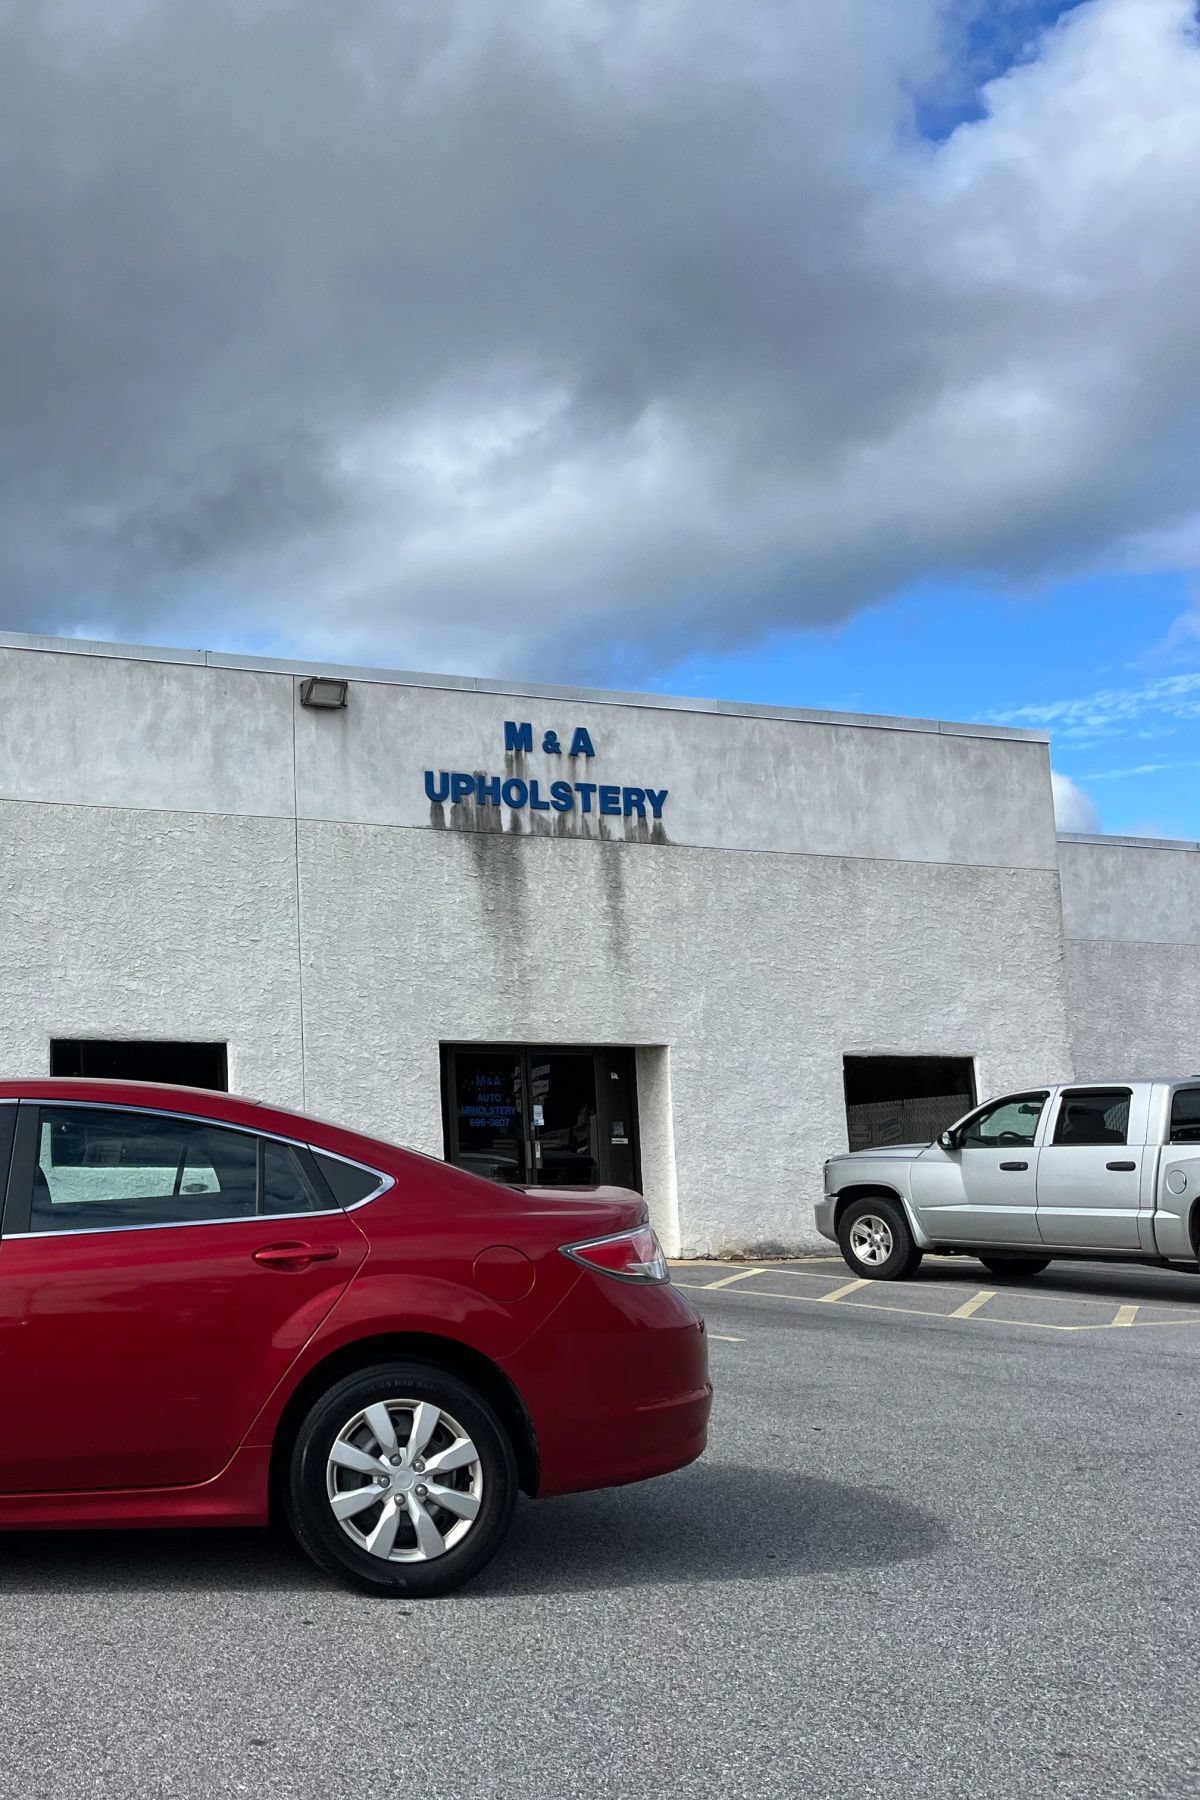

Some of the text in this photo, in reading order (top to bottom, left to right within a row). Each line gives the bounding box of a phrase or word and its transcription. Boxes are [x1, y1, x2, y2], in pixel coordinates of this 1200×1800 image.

[504, 721, 533, 752] M
[569, 727, 595, 757] A
[424, 771, 668, 818] UPHOLSTERY
[477, 1093, 502, 1102] AUTO
[461, 1106, 517, 1115] UPHOLSTERY
